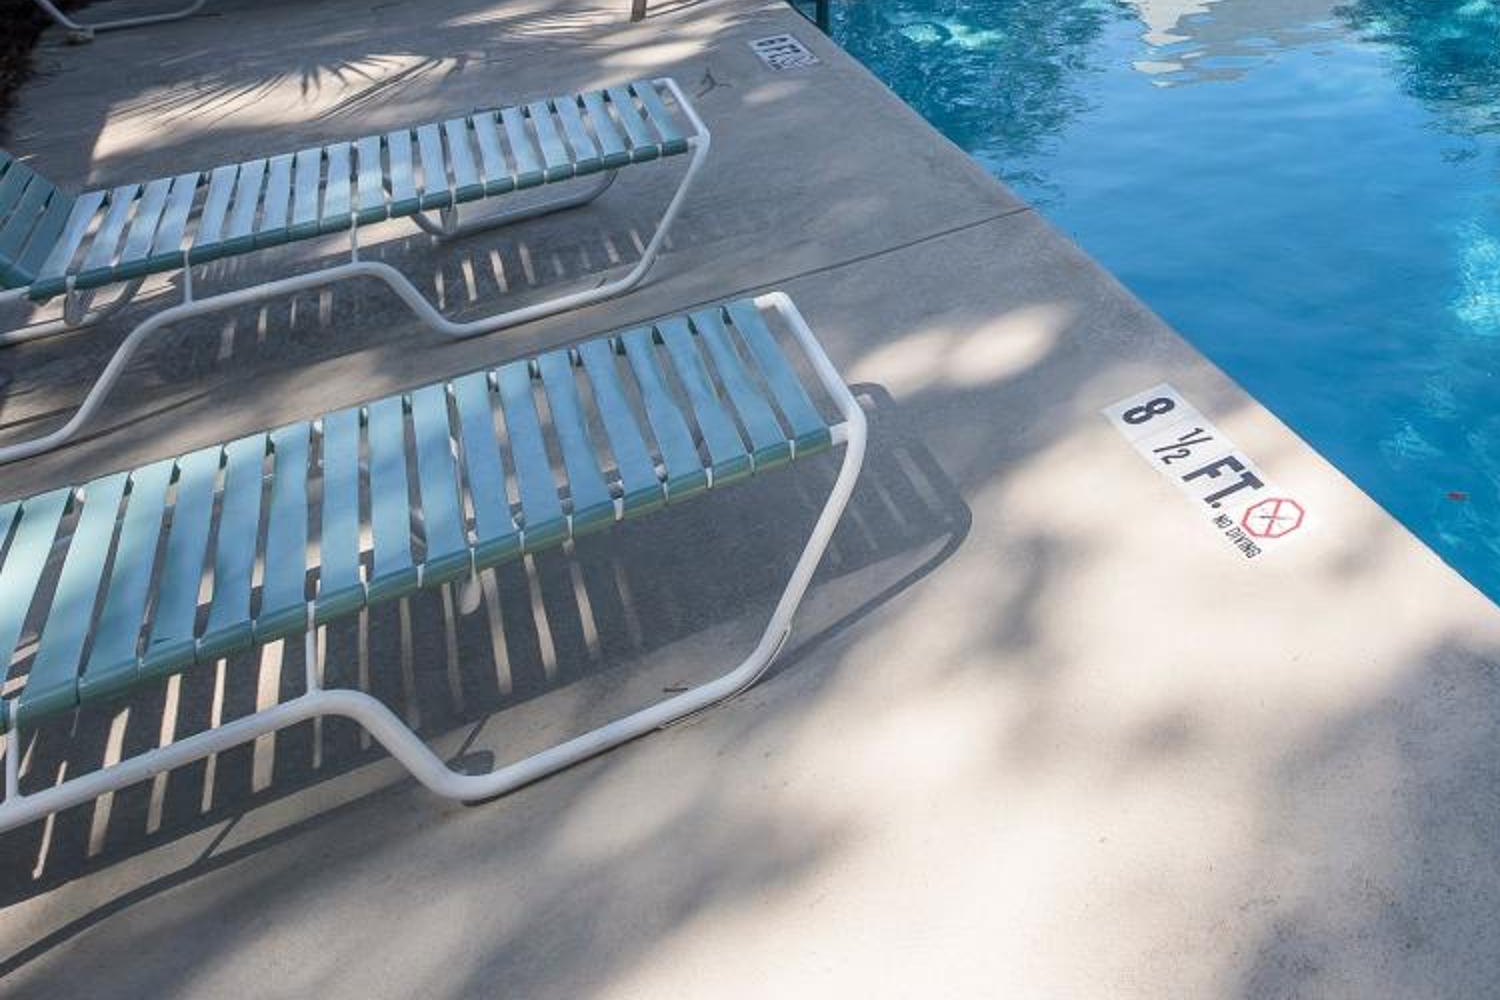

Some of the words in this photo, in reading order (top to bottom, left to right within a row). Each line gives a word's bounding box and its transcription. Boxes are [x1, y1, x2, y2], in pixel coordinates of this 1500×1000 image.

[1122, 397, 1175, 425] 8
[1181, 455, 1265, 509] FT.
[1214, 513, 1233, 529] NO
[1225, 526, 1262, 559] DIVING
